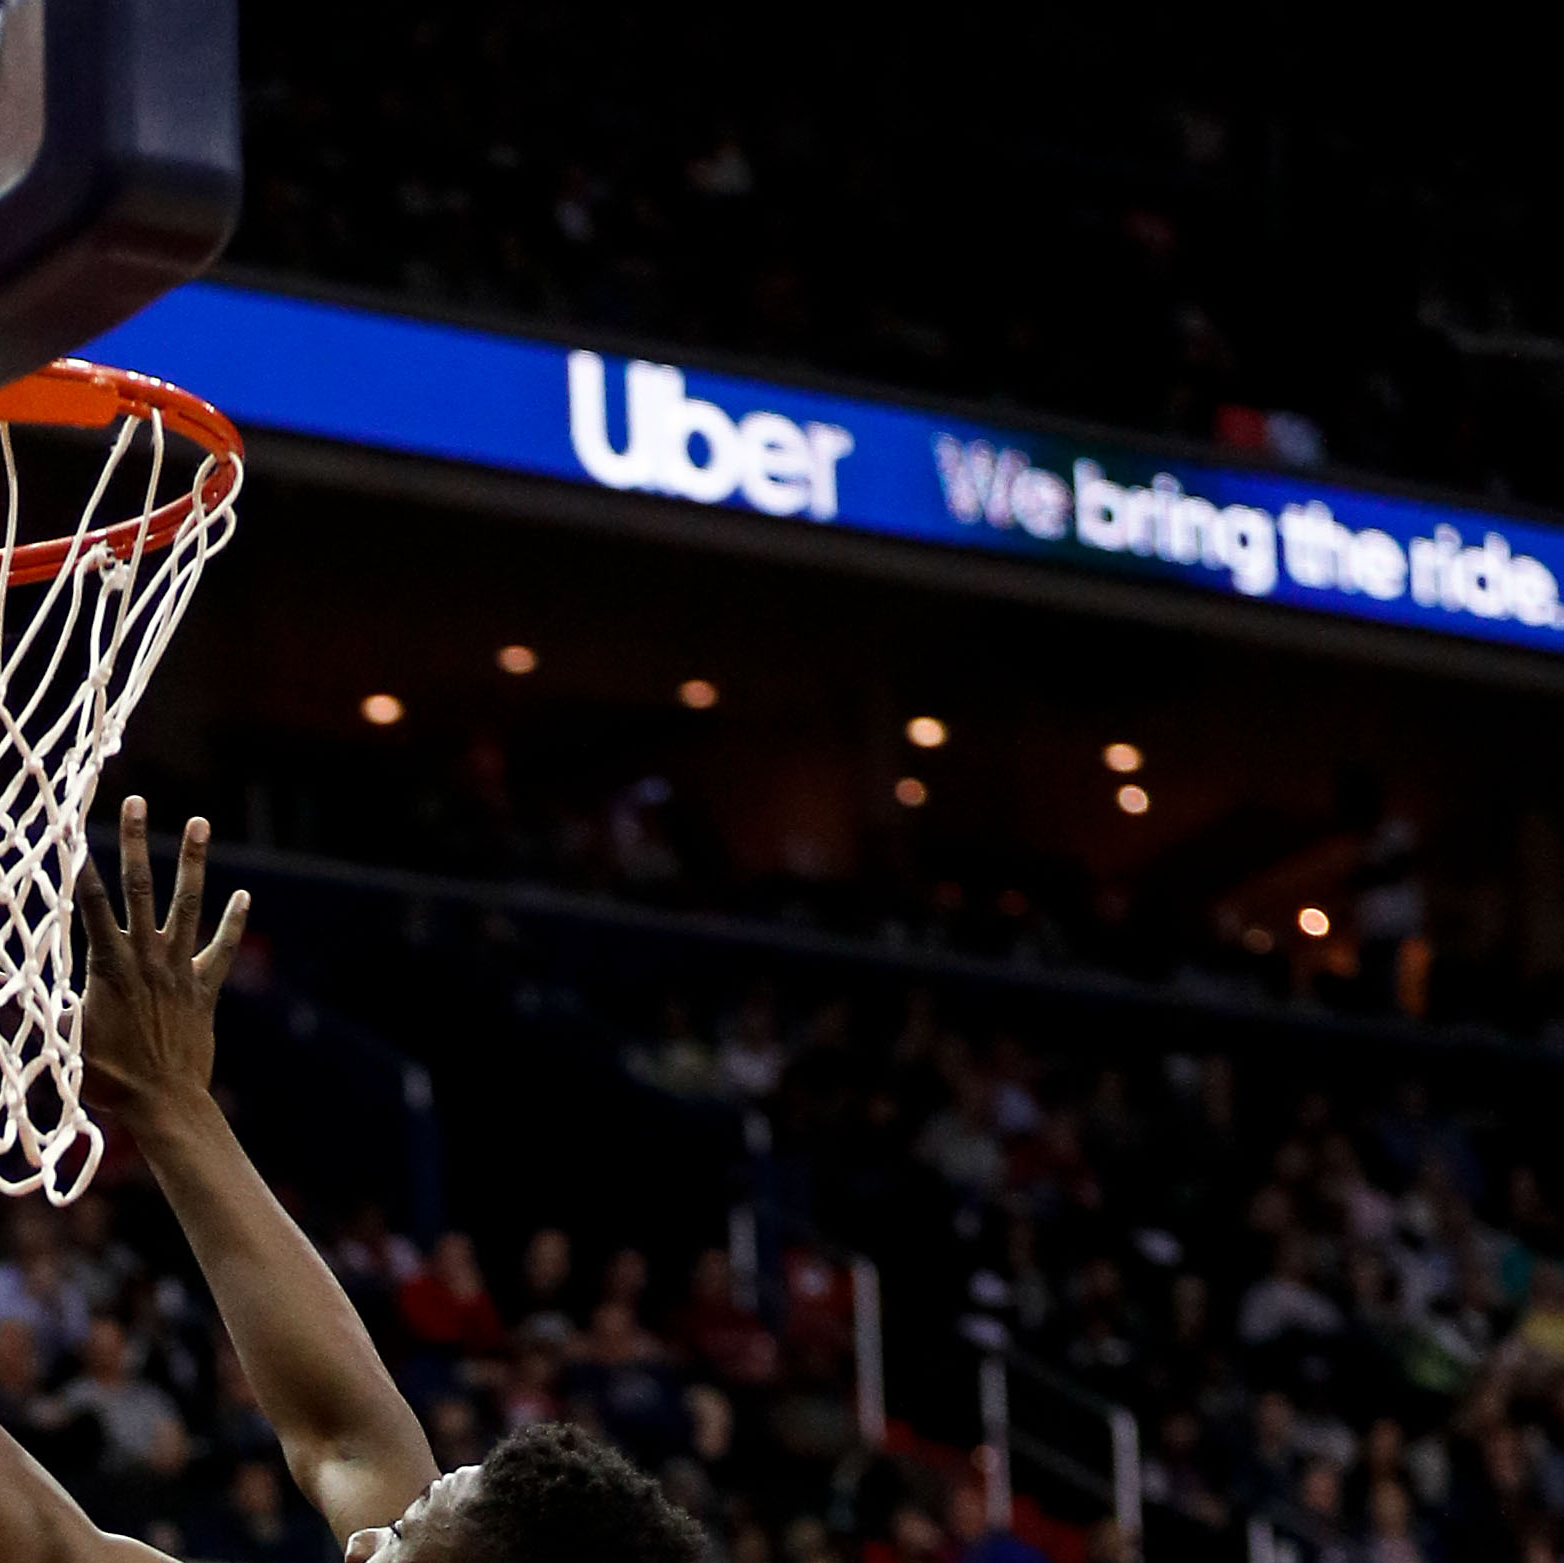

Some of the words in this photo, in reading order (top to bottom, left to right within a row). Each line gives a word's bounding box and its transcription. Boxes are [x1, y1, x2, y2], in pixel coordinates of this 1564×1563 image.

[566, 350, 853, 521] Uber
[935, 431, 1072, 540] We
[1073, 457, 1277, 597] bring
[1277, 500, 1409, 600] the
